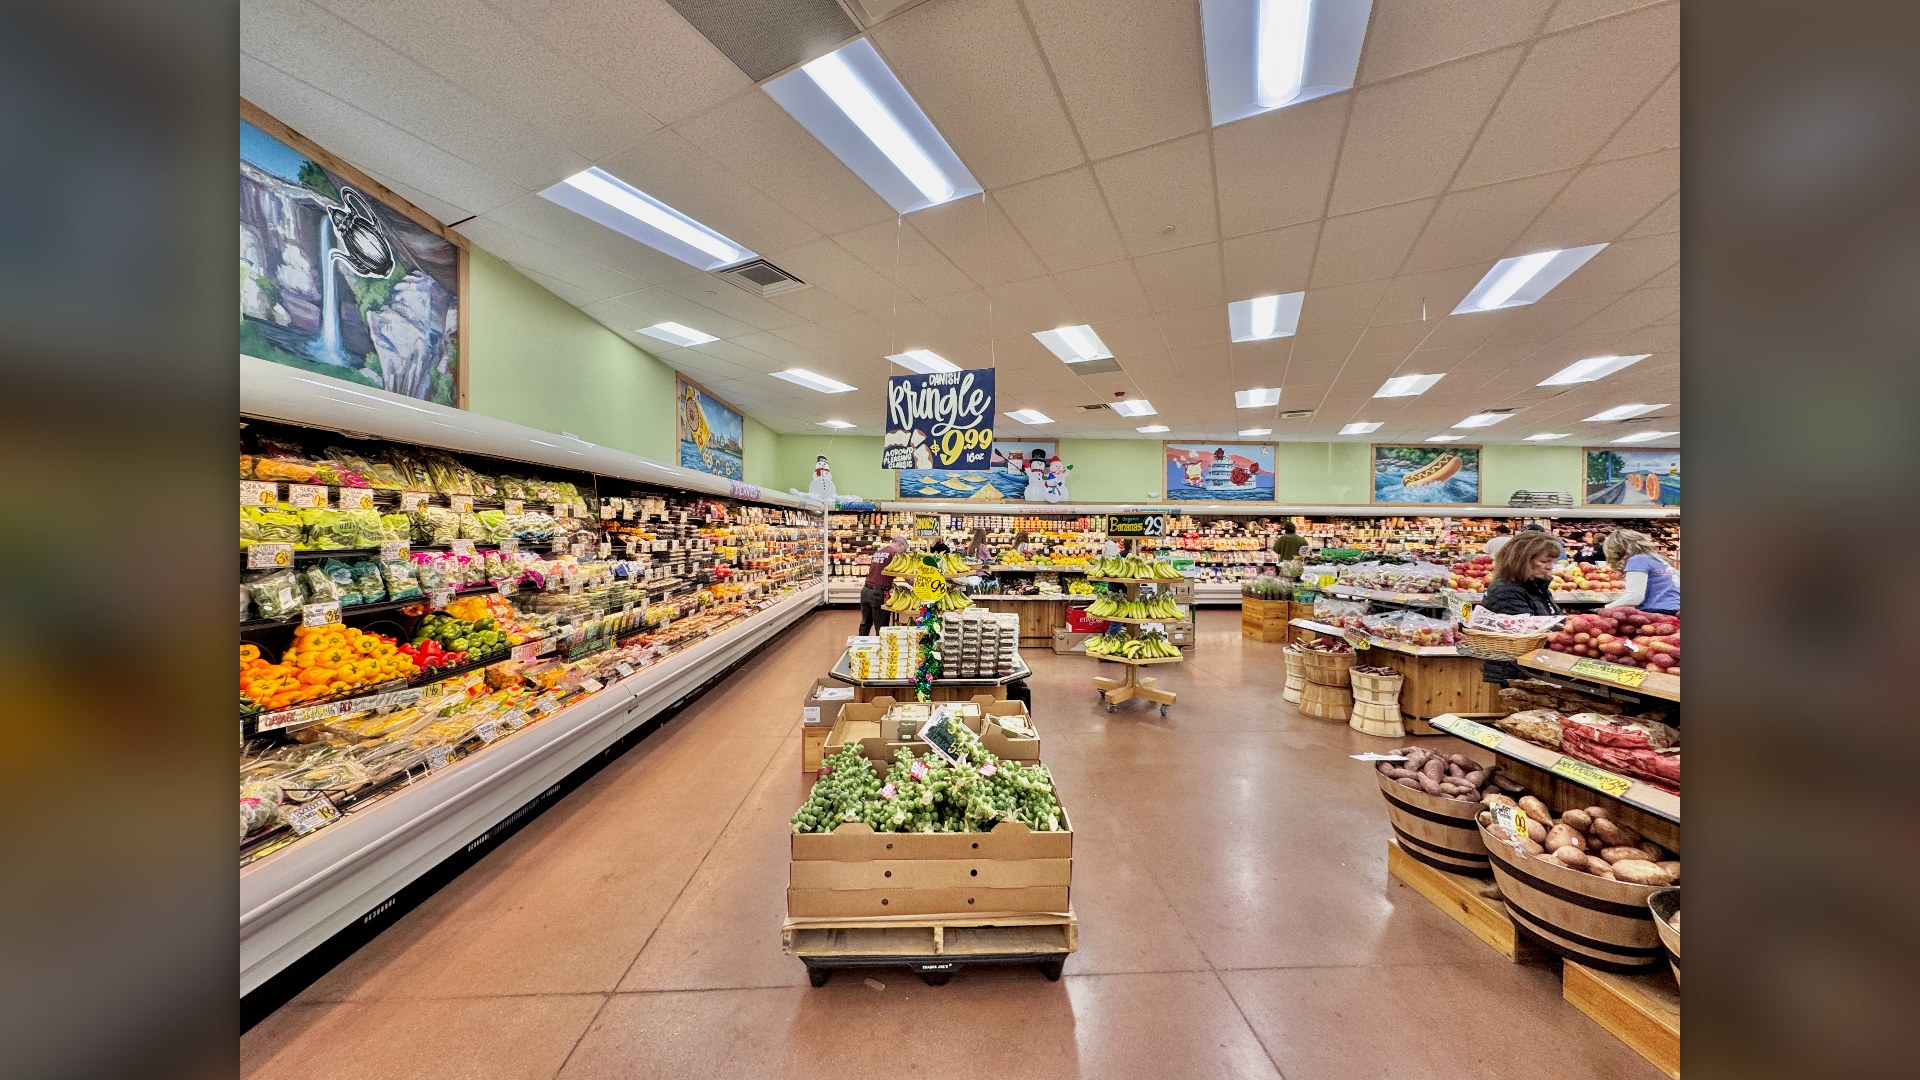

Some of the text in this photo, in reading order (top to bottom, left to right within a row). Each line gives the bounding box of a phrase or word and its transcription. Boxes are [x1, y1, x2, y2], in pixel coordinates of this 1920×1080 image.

[929, 371, 961, 386] DANISH
[888, 373, 991, 437] Kringle
[1109, 517, 1143, 532] Bananas
